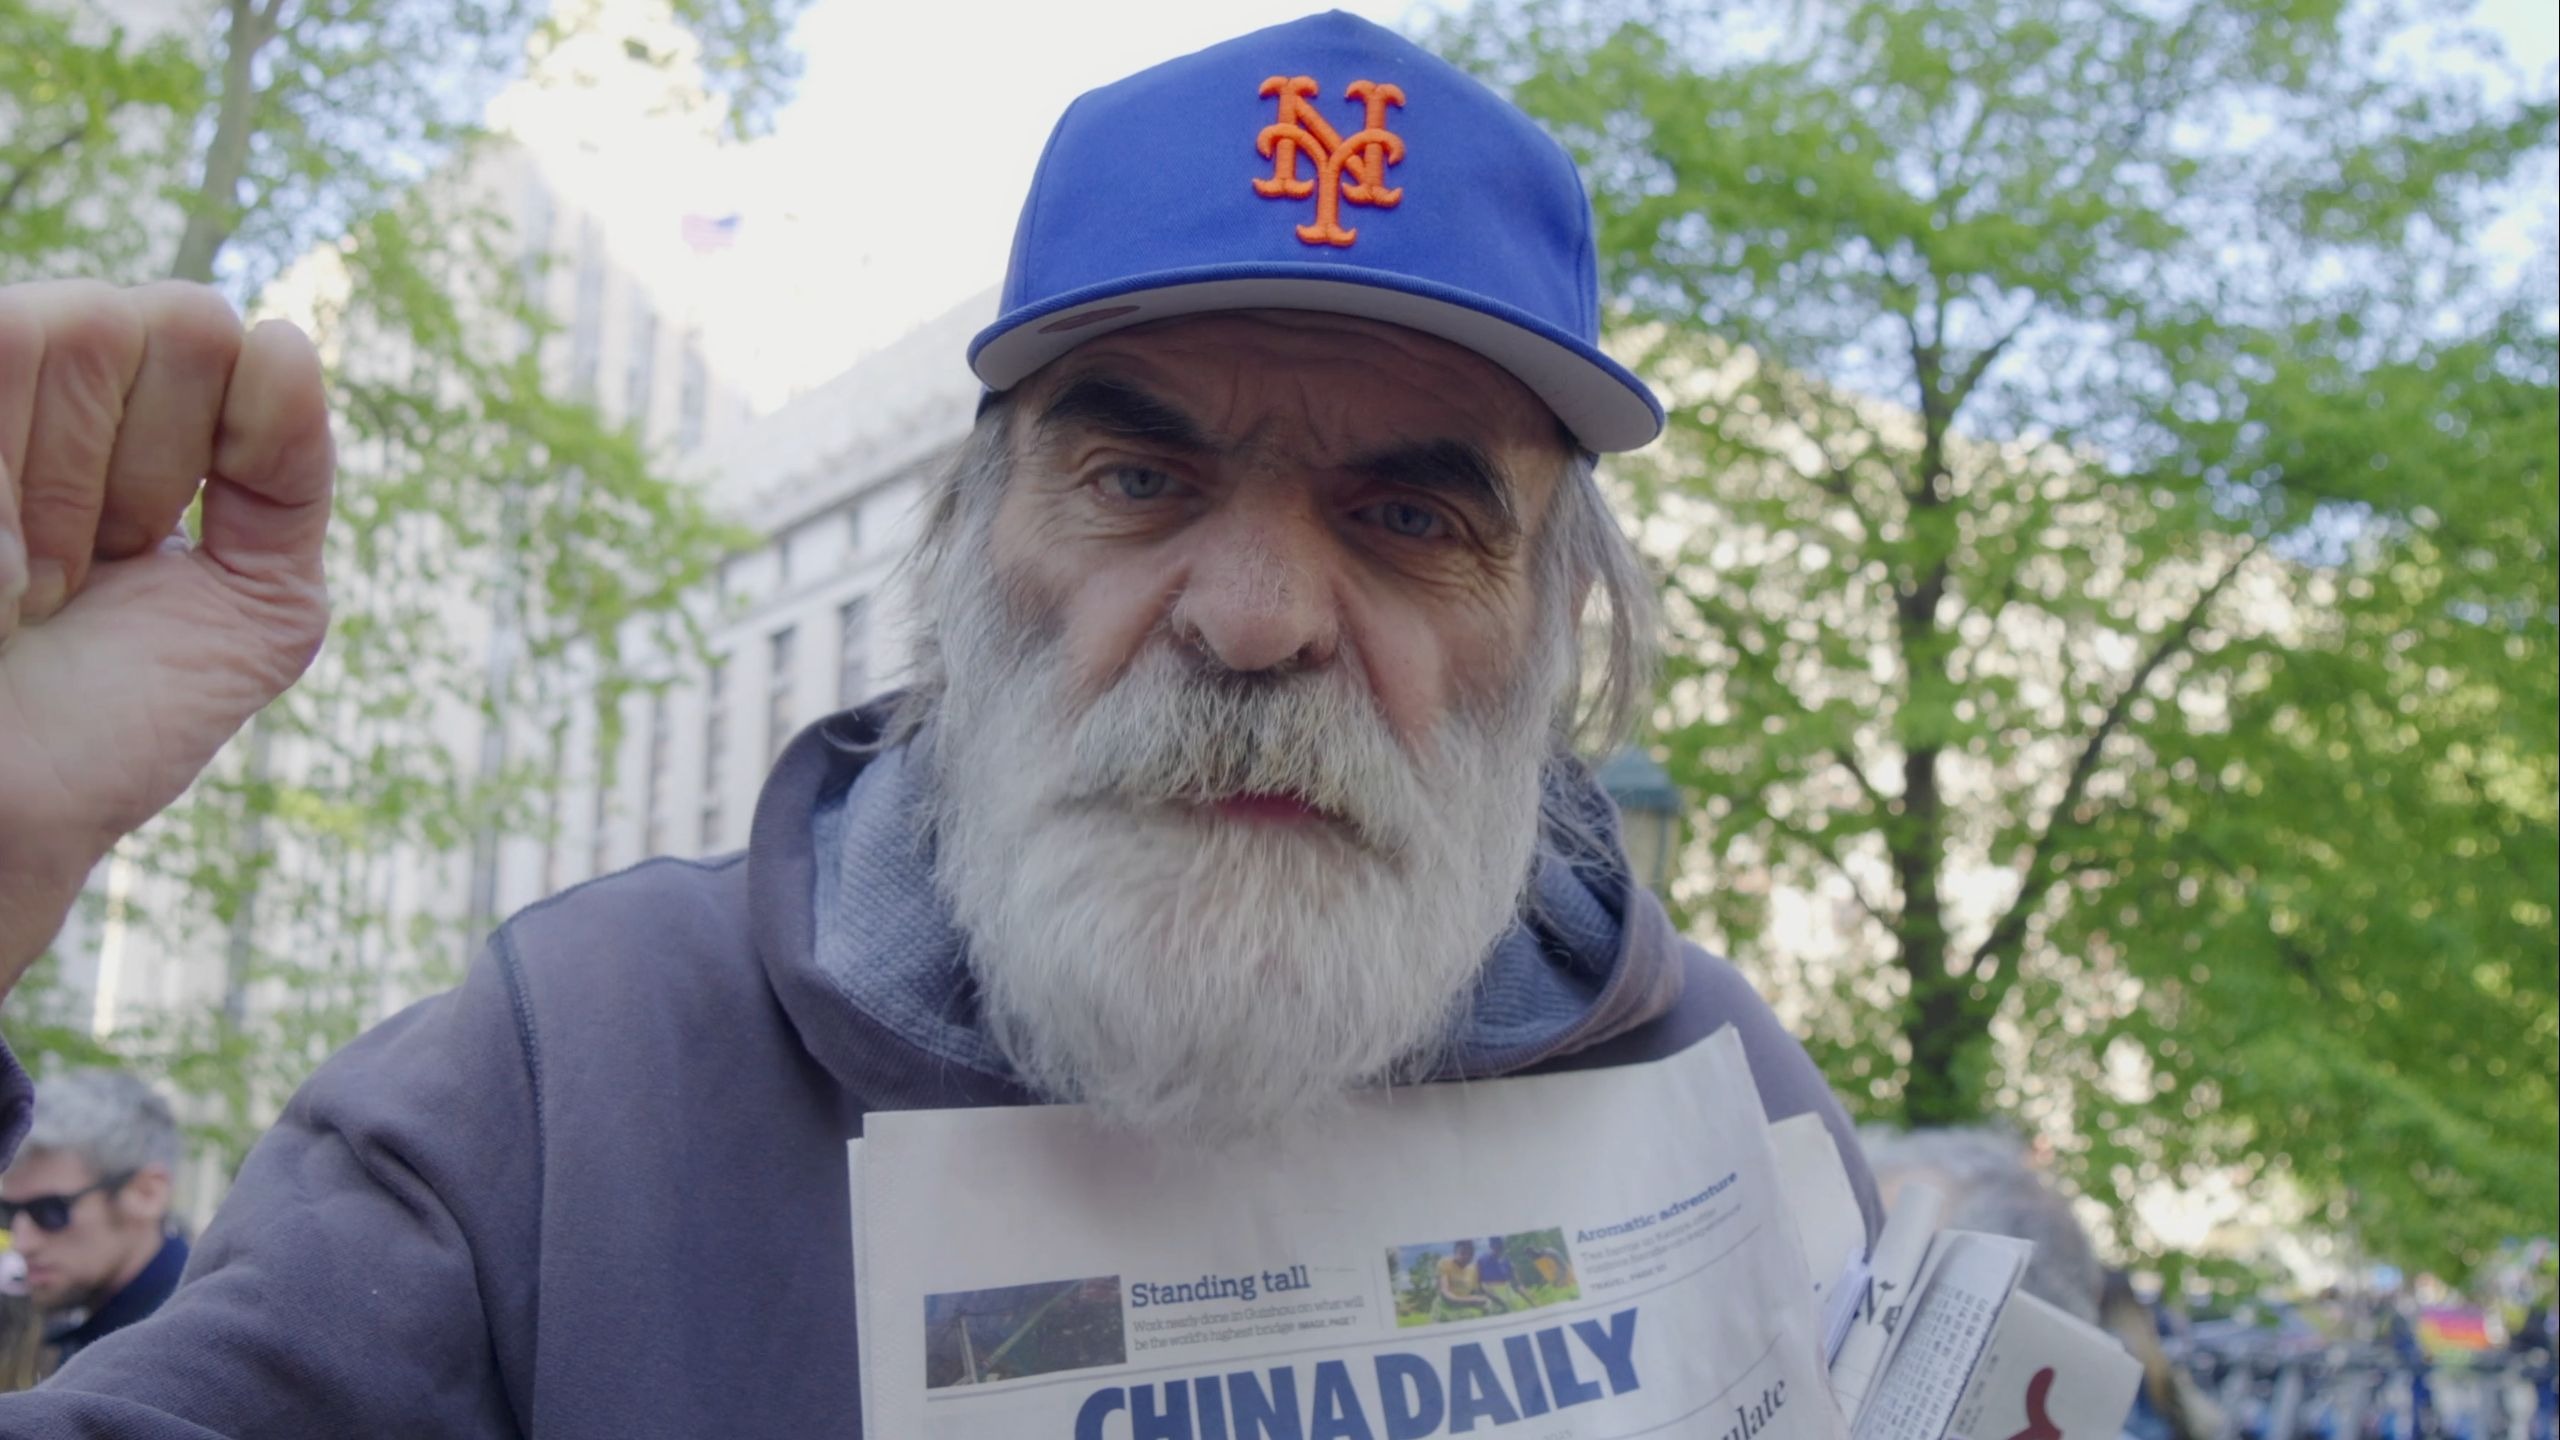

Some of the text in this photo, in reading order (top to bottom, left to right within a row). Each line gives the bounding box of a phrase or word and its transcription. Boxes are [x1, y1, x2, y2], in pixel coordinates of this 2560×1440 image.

[1253, 74, 1406, 247] NY
[1577, 1171, 1738, 1244] Aromatic adventure
[1131, 1264, 1311, 1308] Standing tall
[1133, 1318, 1164, 1333] Work
[1201, 1311, 1229, 1326] done
[1135, 1338, 1149, 1352] be
[1150, 1335, 1168, 1349] the
[1209, 1323, 1255, 1344] highest
[1256, 1319, 1296, 1337] bridge
[1075, 1307, 1641, 1440] CHINA DAILY
